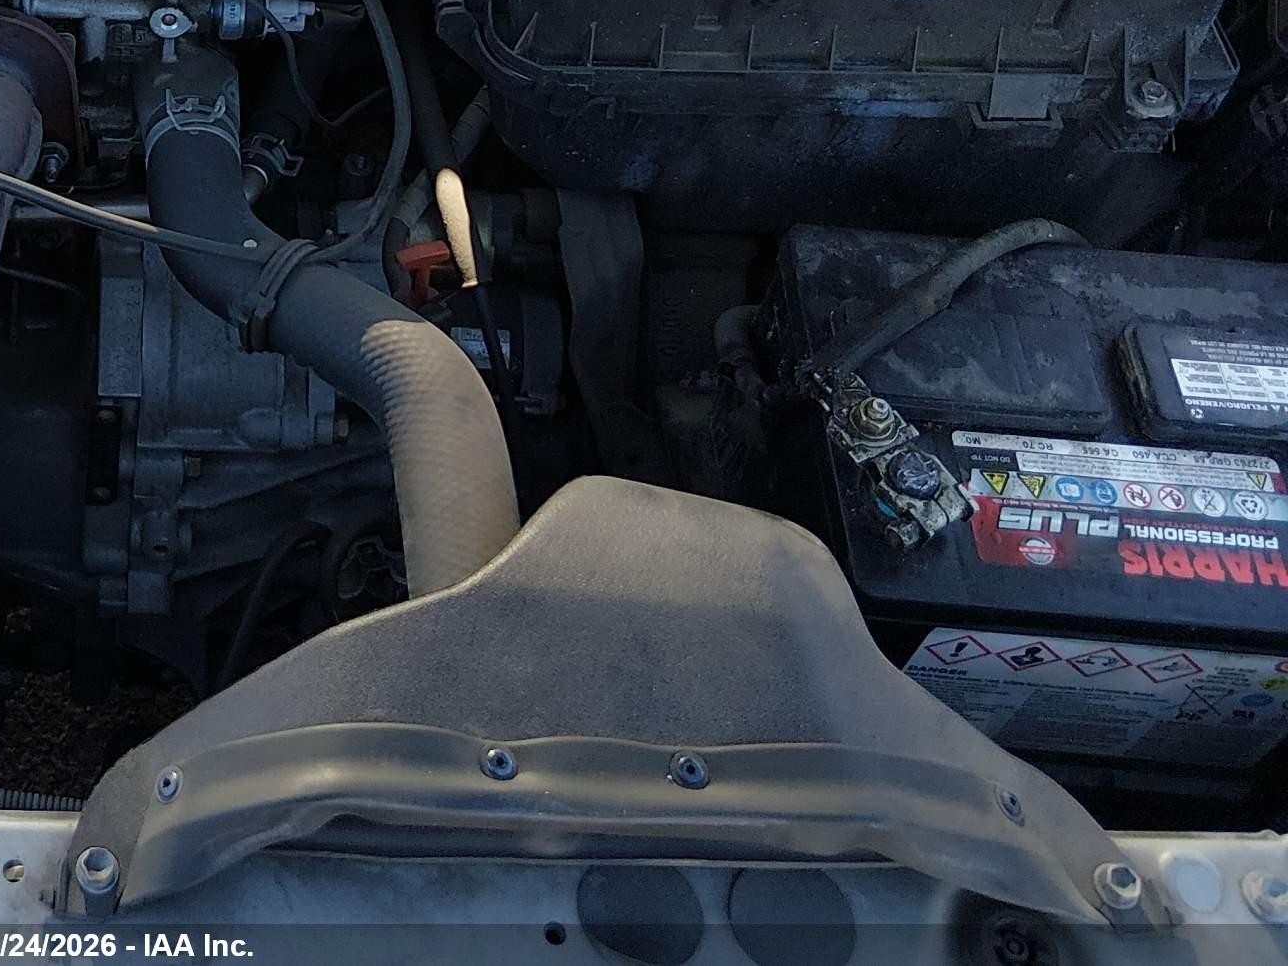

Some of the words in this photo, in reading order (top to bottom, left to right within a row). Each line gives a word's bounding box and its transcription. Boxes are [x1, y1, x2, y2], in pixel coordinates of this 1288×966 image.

[1022, 441, 1036, 449] 70
[1038, 442, 1054, 451] RC
[1102, 447, 1119, 458] CA
[1152, 452, 1177, 461] CCA
[983, 454, 1000, 463] NOT
[999, 455, 1011, 464] DO
[998, 507, 1120, 538] PLUS
[1123, 524, 1280, 549] PROFESSIONAL
[1117, 539, 1288, 587] HARRIS
[907, 664, 969, 676] DANGER
